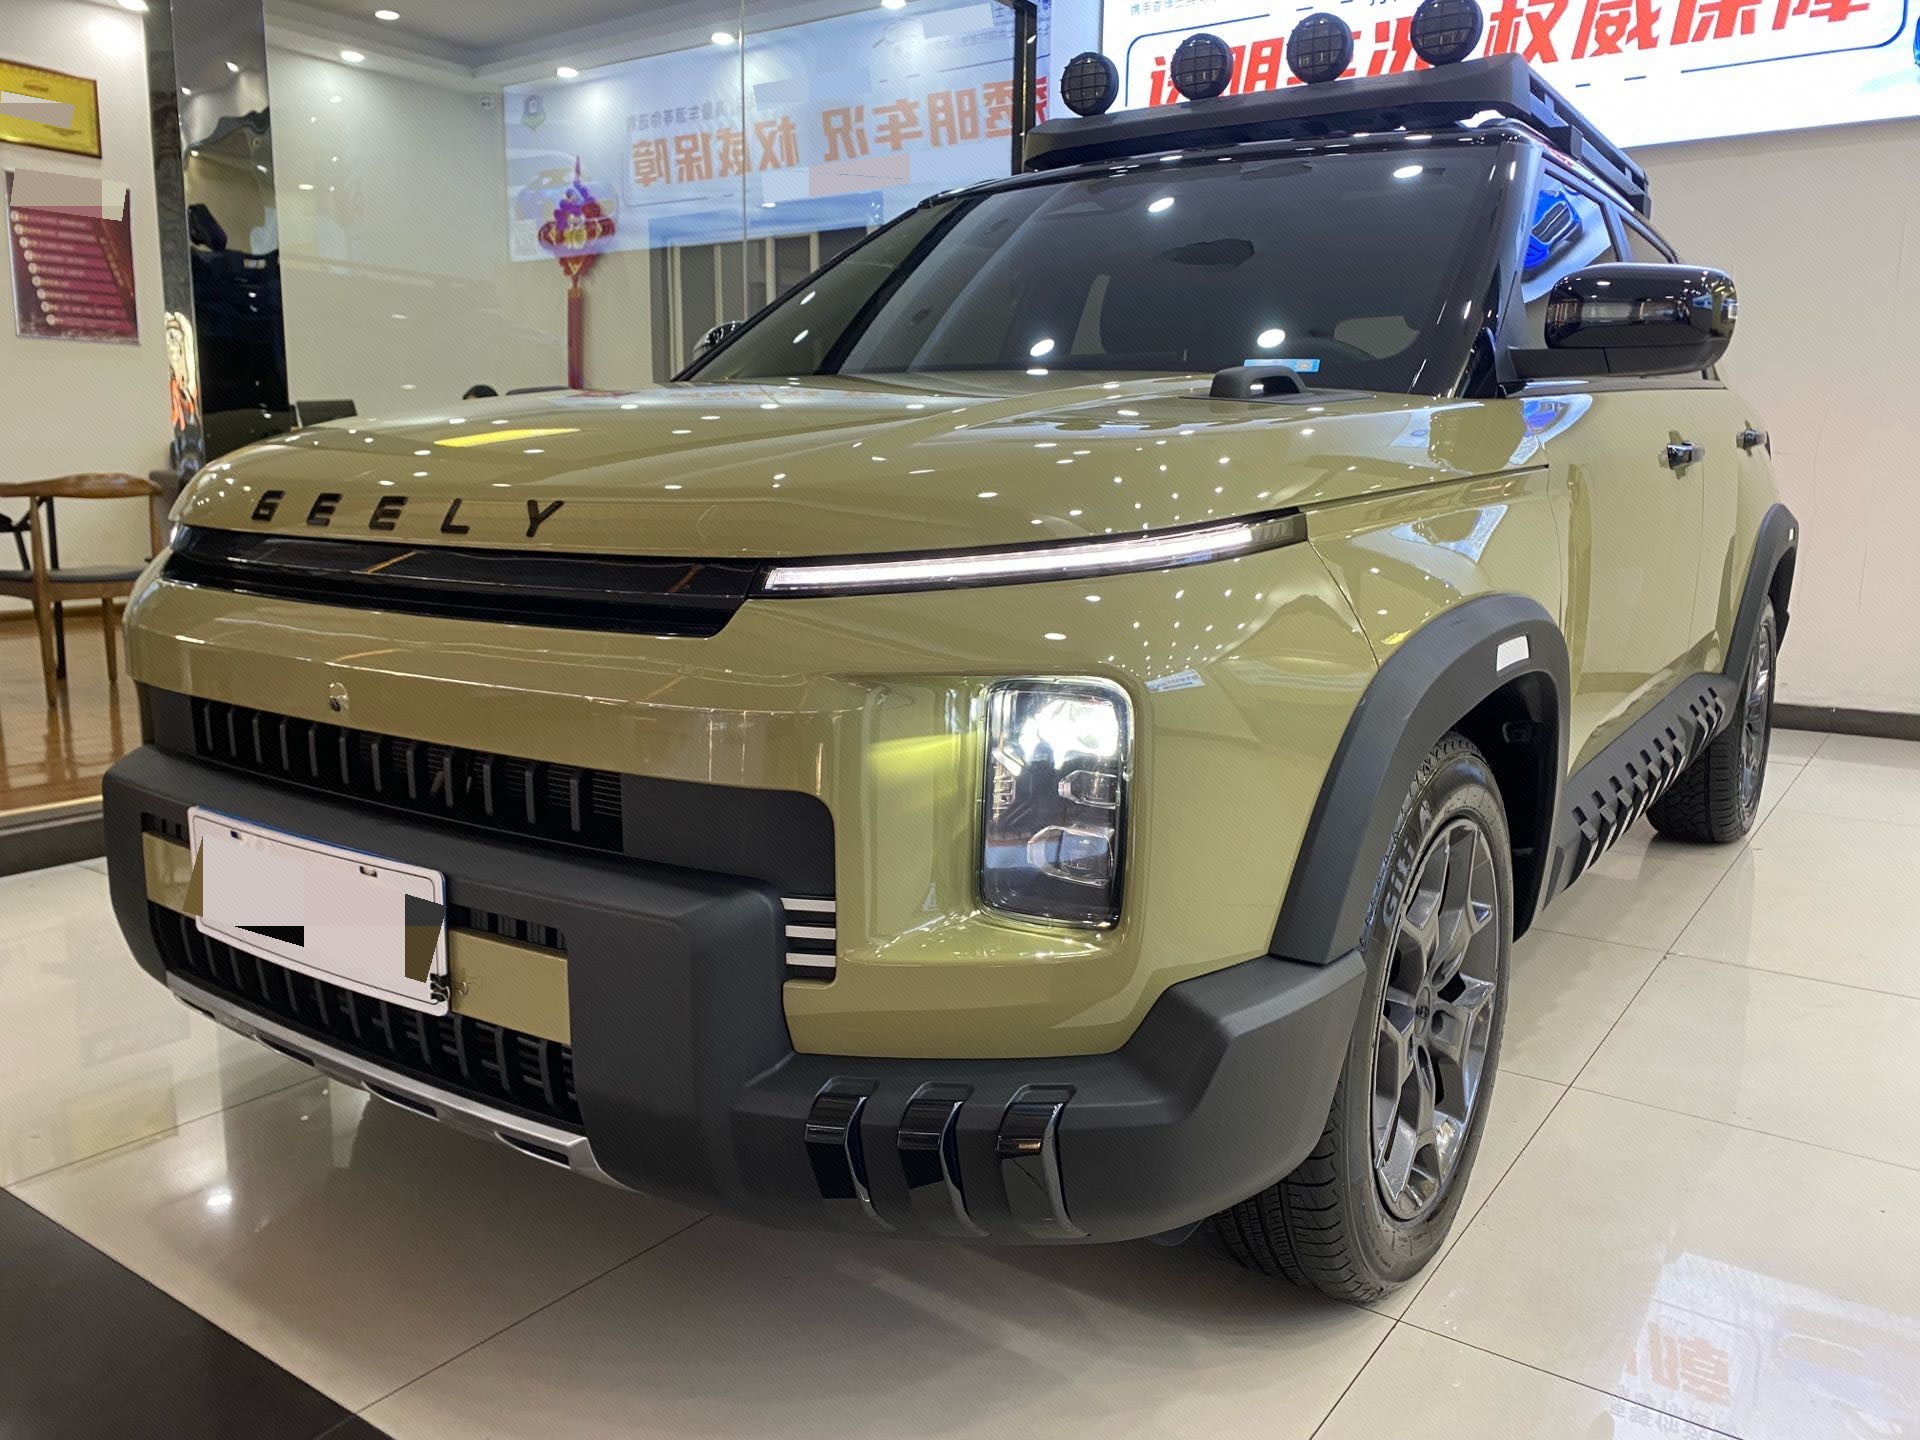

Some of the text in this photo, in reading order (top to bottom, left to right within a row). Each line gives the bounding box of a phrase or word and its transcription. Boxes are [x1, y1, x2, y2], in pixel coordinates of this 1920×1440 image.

[1149, 0, 1872, 107] 明况 权威保
[250, 490, 565, 538] GEELY
[1382, 838, 1415, 928] Giti
